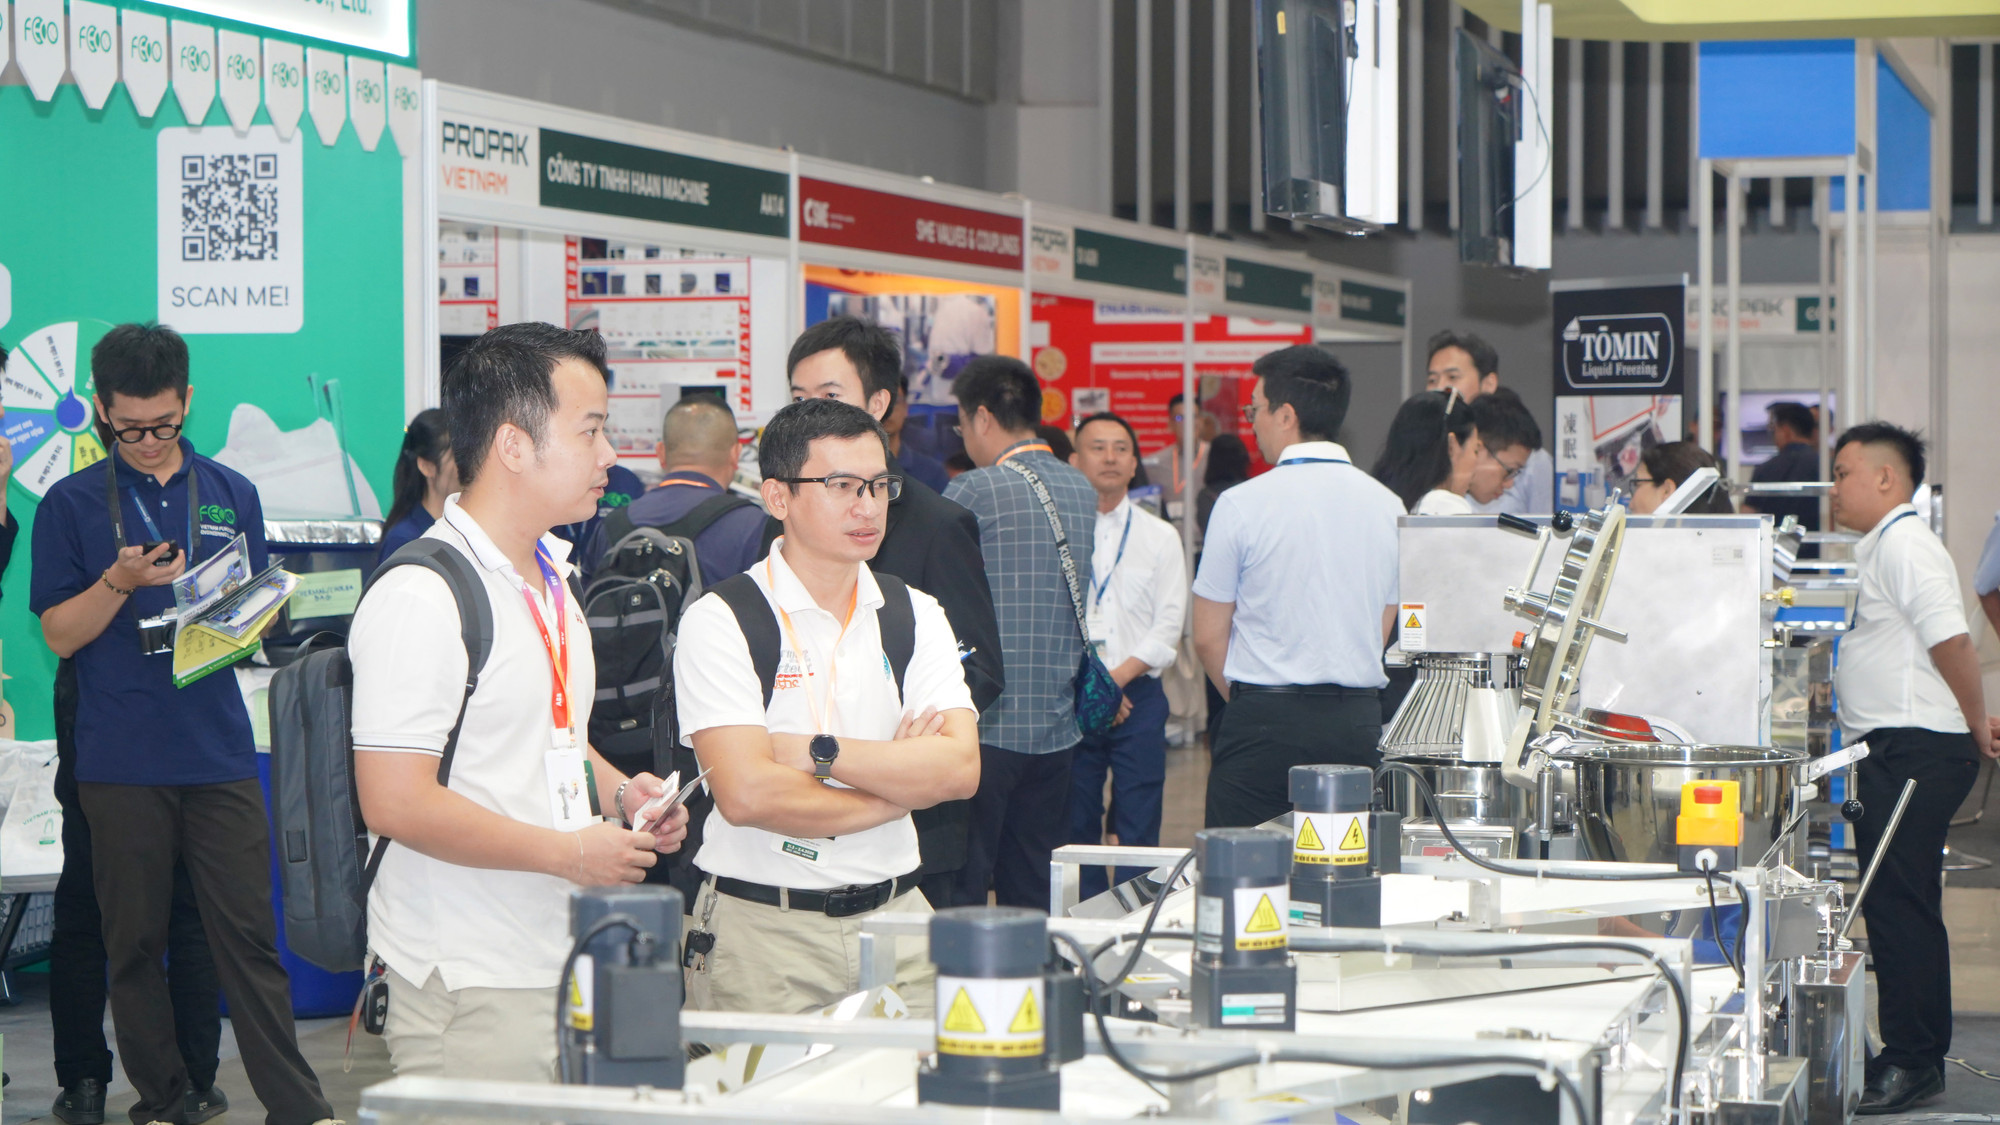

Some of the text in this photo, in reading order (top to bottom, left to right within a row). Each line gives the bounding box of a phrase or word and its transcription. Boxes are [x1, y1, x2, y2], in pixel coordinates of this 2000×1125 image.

[442, 121, 529, 166] PROPAK
[442, 164, 508, 195] VIETNAM
[547, 152, 710, 206] CÔNG TY TNHH HAAN MACHINE
[171, 286, 289, 307] SCAN ME!
[1582, 362, 1658, 379] Liquid Freezing
